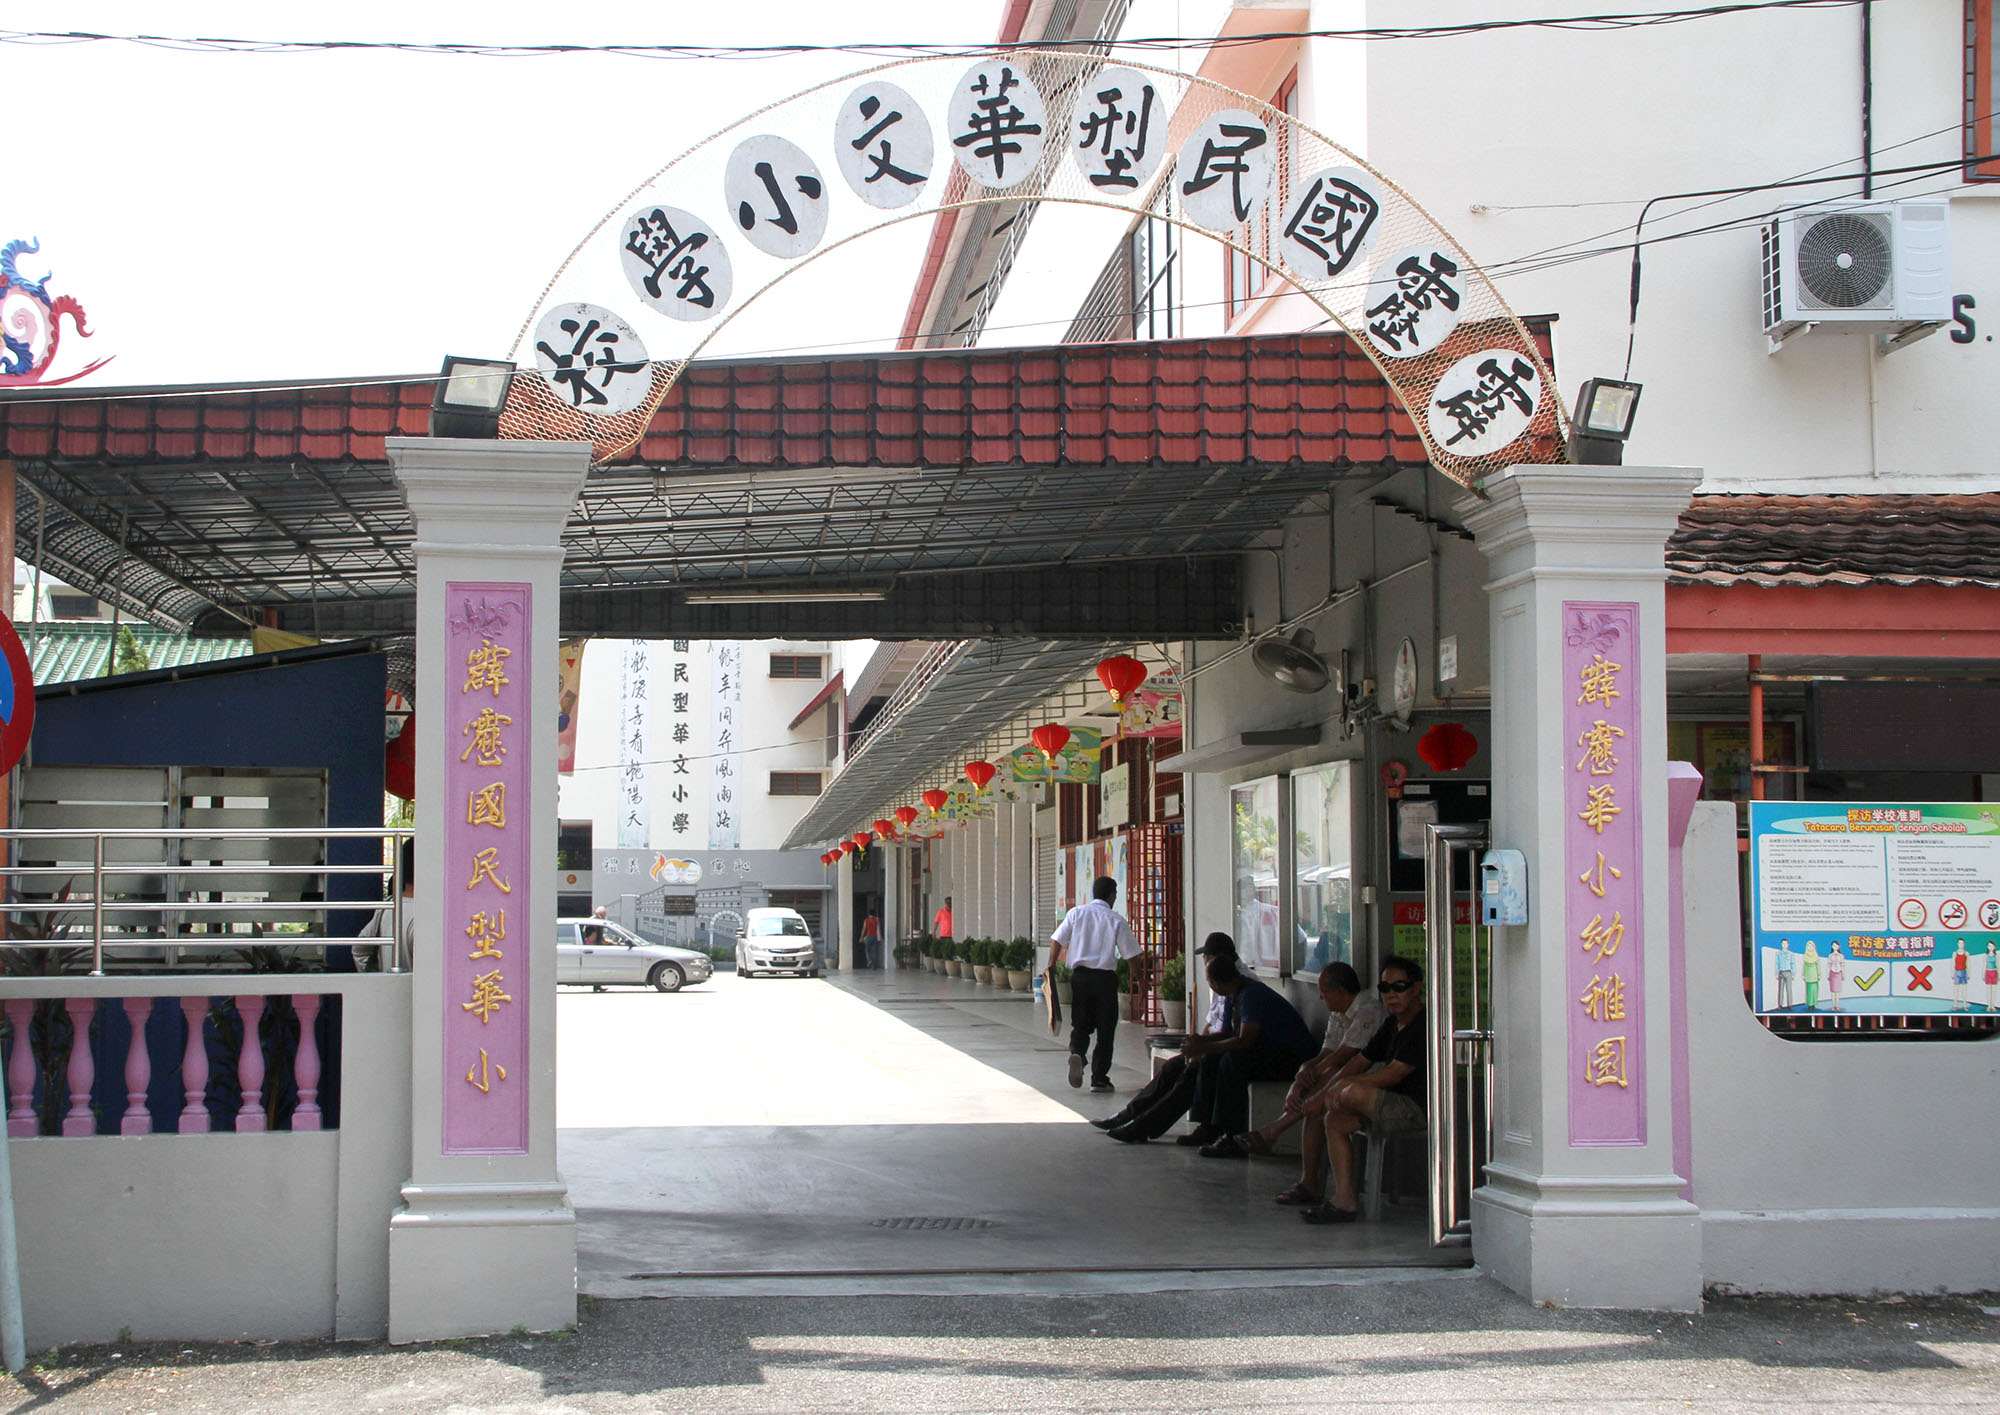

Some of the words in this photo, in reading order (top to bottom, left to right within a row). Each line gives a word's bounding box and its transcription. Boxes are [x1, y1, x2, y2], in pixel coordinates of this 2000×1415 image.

[1847, 808, 1922, 823] 探访学校准则
[1803, 821, 1847, 833] Tatacara
[1849, 821, 1896, 833] Berurusan
[1898, 822, 1929, 835] dengan
[1931, 822, 1967, 833] Sekolah
[1848, 935, 1935, 949] 探访者穿着指南
